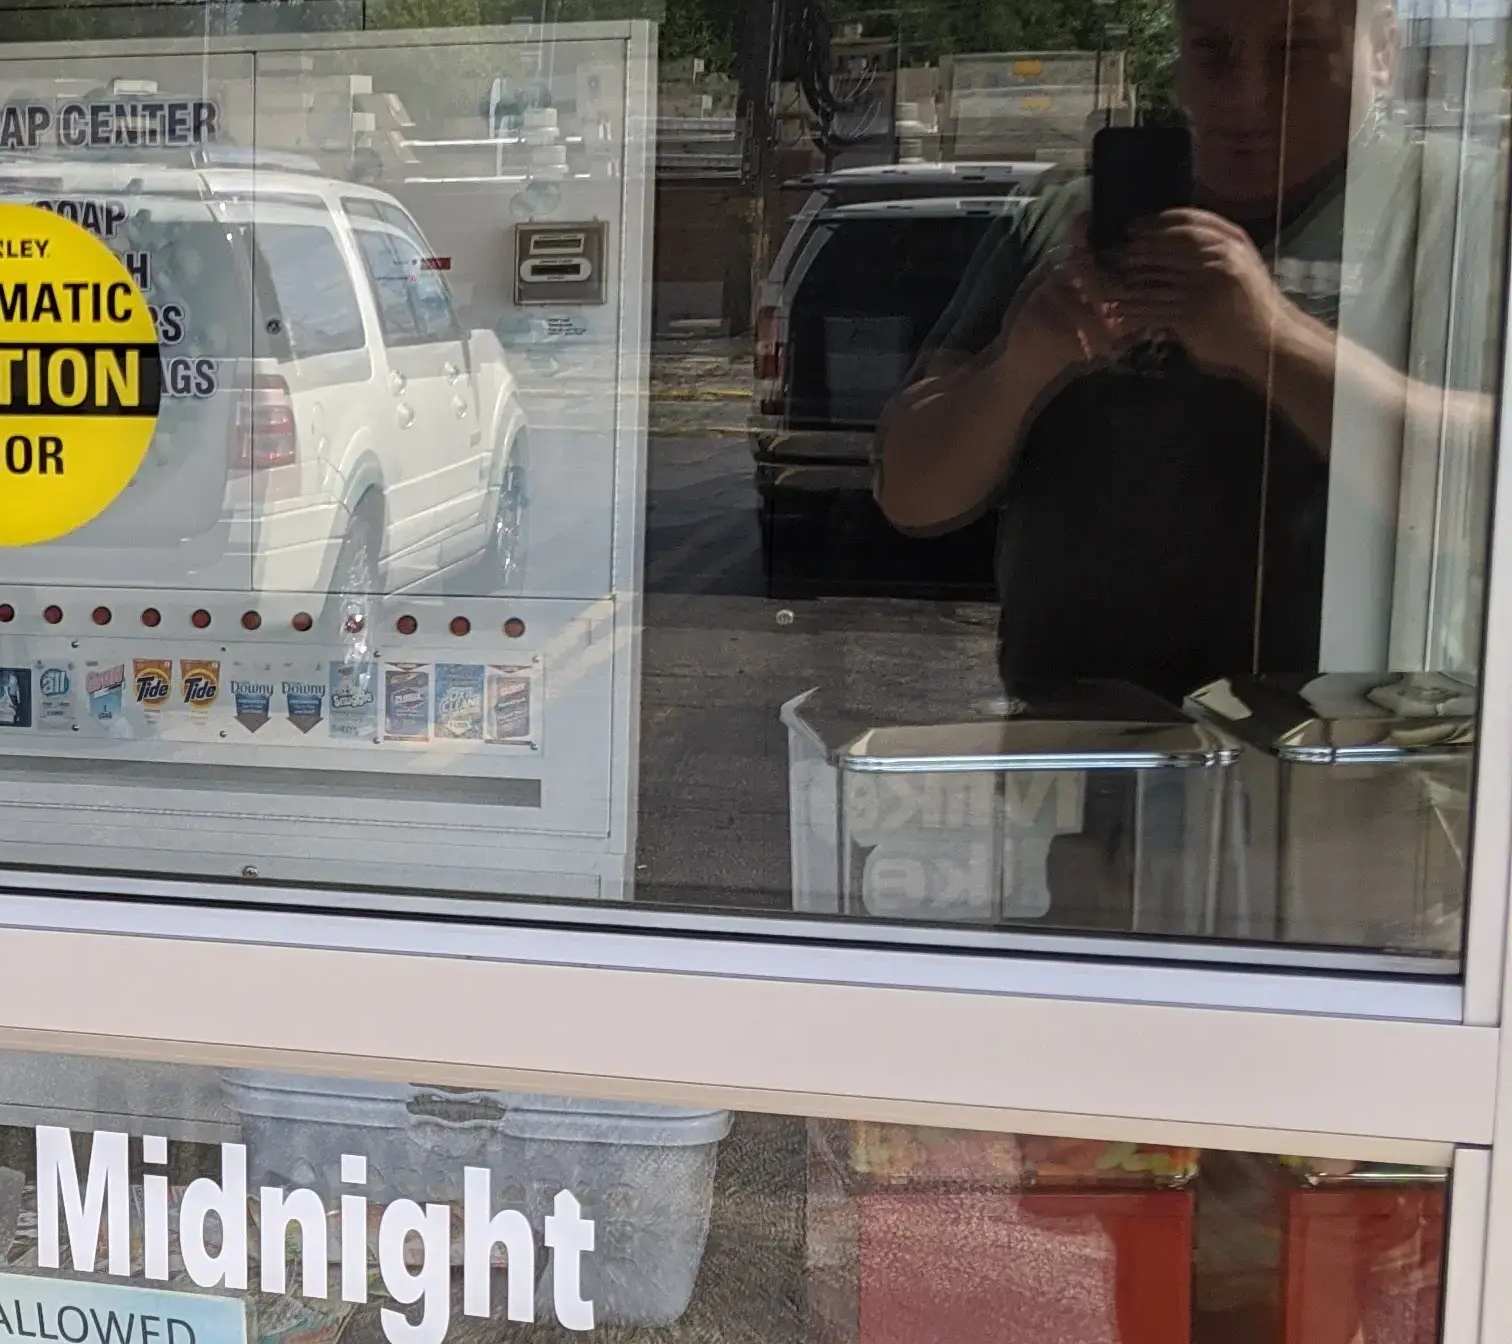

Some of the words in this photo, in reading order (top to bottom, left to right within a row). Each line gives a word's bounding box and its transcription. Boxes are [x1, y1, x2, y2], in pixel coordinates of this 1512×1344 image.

[59, 102, 219, 147] CENTER
[43, 669, 66, 696] all
[136, 676, 169, 703] Tide
[184, 677, 216, 703] Tide
[230, 681, 275, 697] Downy
[281, 681, 327, 698] Downy
